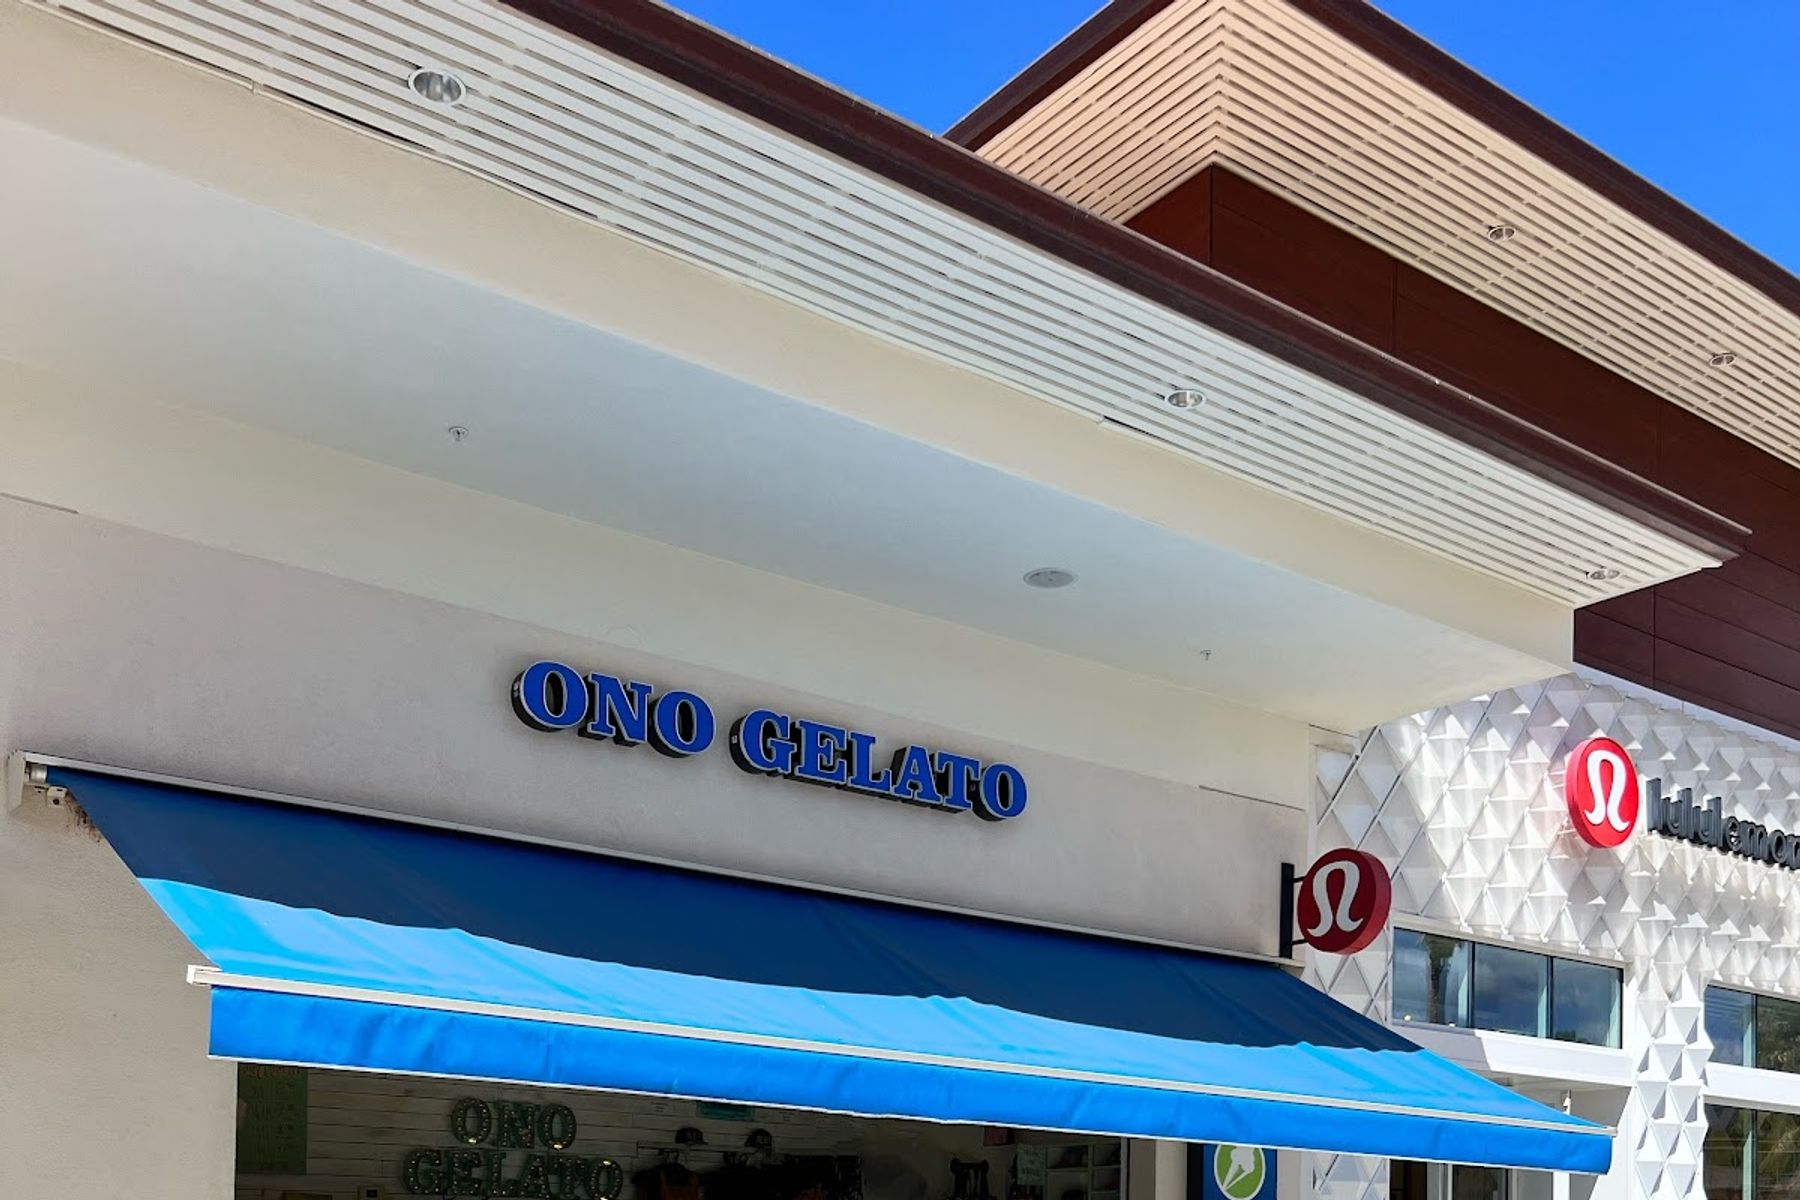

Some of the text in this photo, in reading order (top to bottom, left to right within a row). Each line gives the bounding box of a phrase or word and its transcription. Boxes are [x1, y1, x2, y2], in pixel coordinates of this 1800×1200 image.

[512, 660, 1028, 821] ONO GELATO
[452, 1097, 577, 1150] ONO
